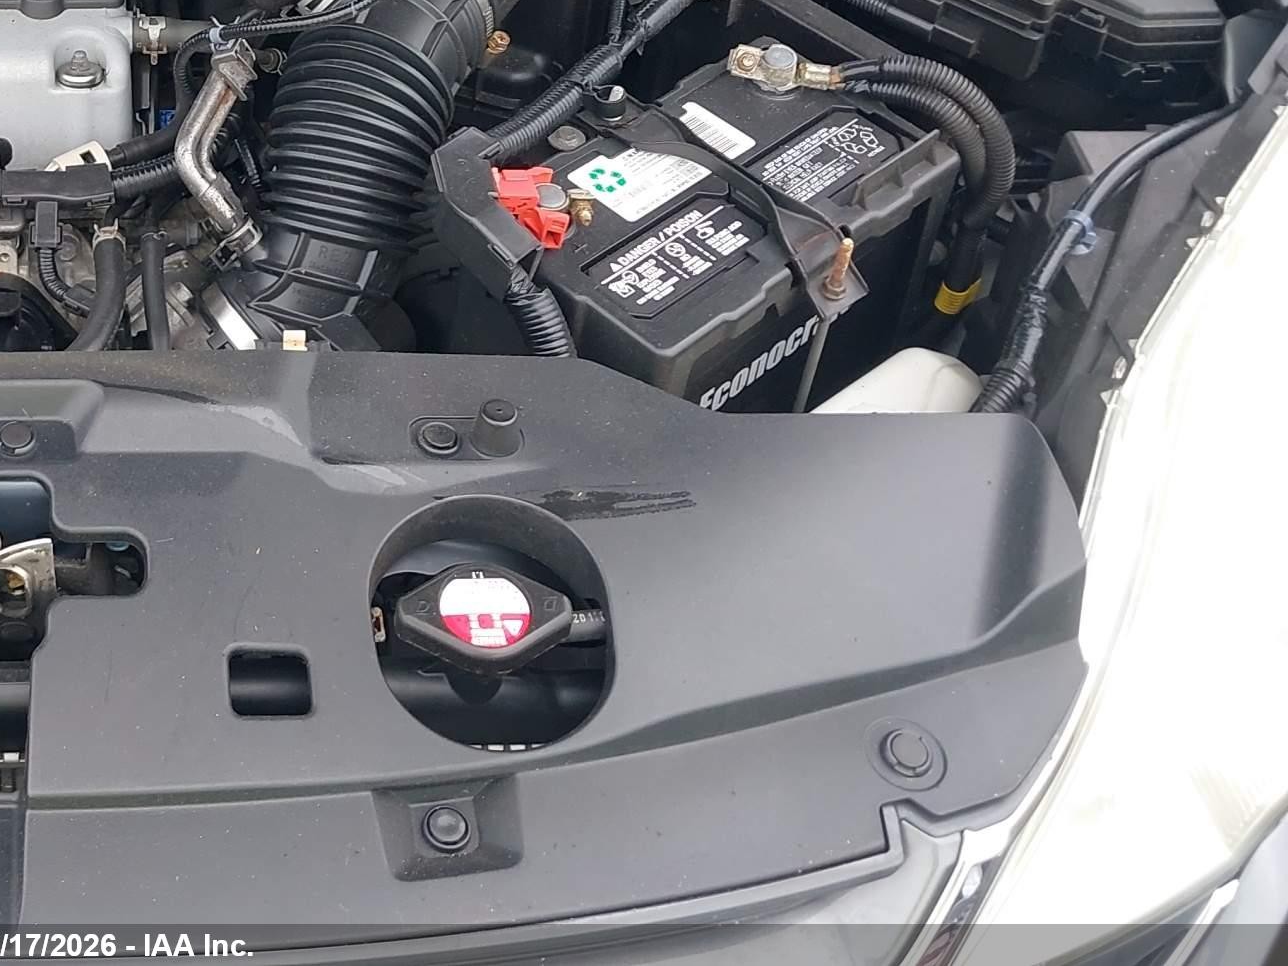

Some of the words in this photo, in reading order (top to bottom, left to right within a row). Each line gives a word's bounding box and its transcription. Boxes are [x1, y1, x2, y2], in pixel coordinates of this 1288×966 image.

[617, 236, 661, 265] DANGER
[664, 209, 704, 236] POISON
[699, 306, 849, 411] Econocr
